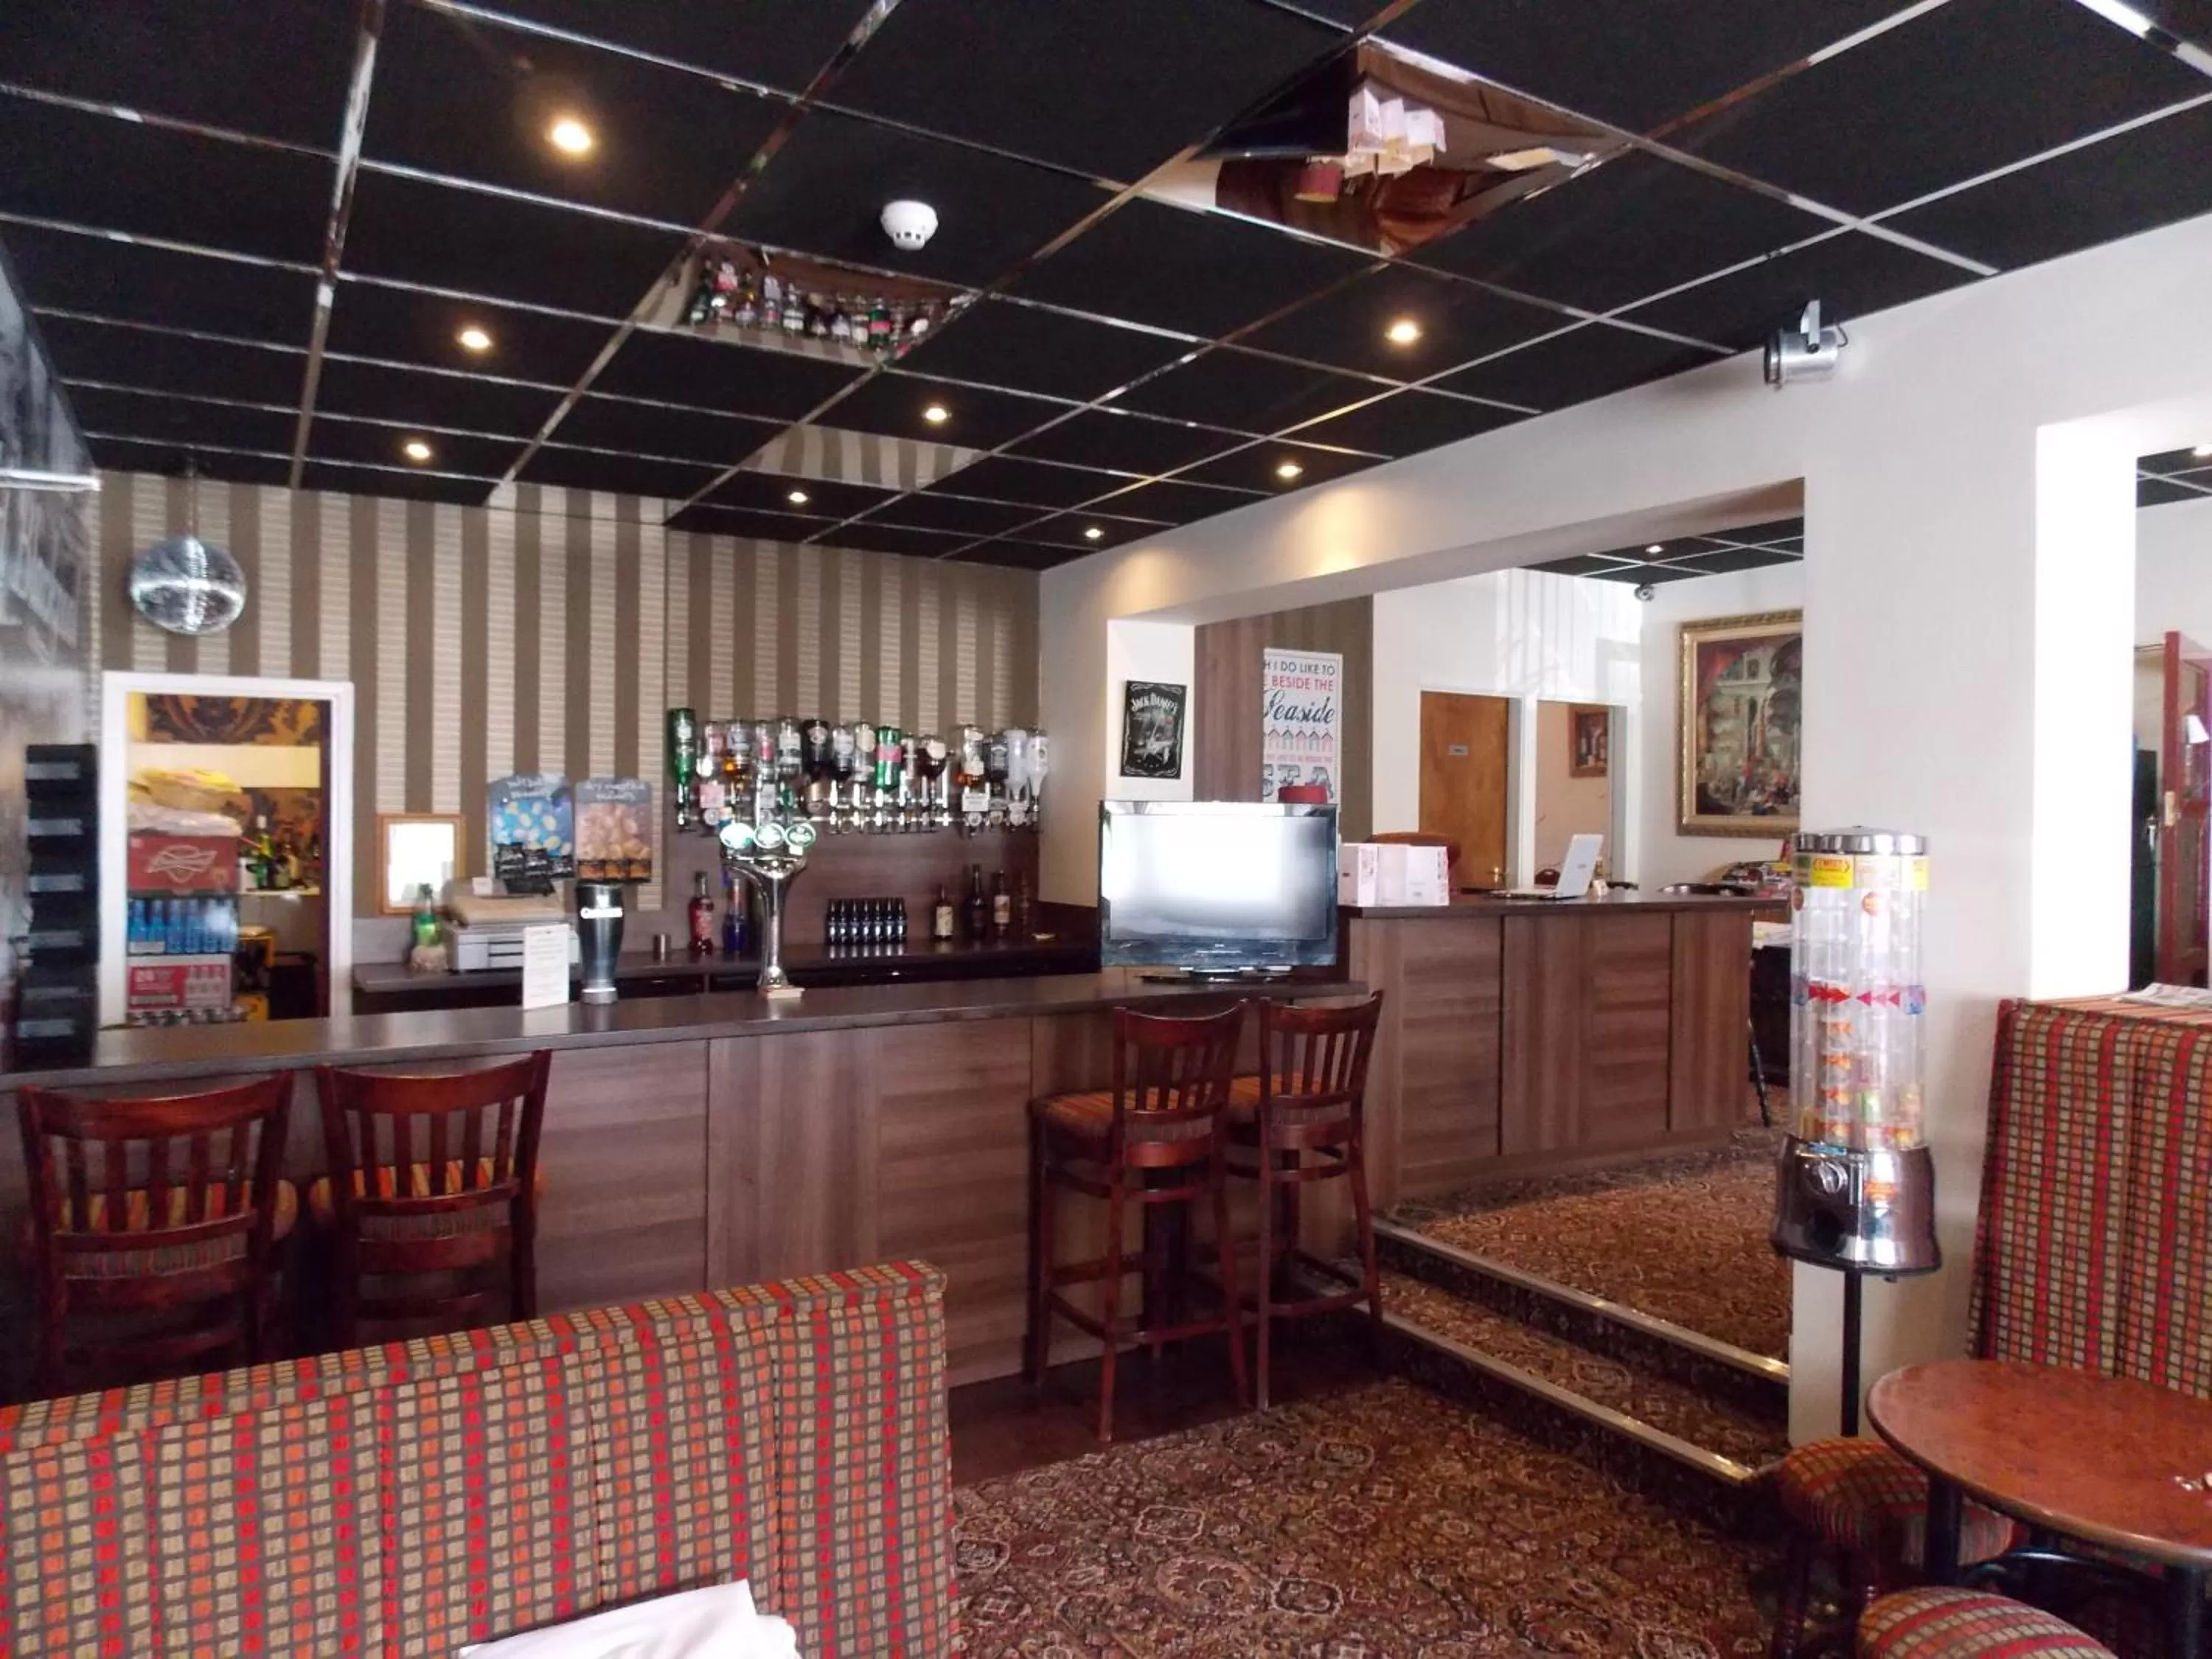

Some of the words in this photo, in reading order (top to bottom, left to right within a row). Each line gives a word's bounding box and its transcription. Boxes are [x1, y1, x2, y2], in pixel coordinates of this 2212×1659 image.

[1281, 661, 1297, 672] DO
[1300, 663, 1320, 675] LIKE
[1322, 664, 1335, 676] TO
[1272, 675, 1310, 690] BESIDE
[1314, 678, 1334, 692] THE
[1263, 689, 1335, 725] Seaside
